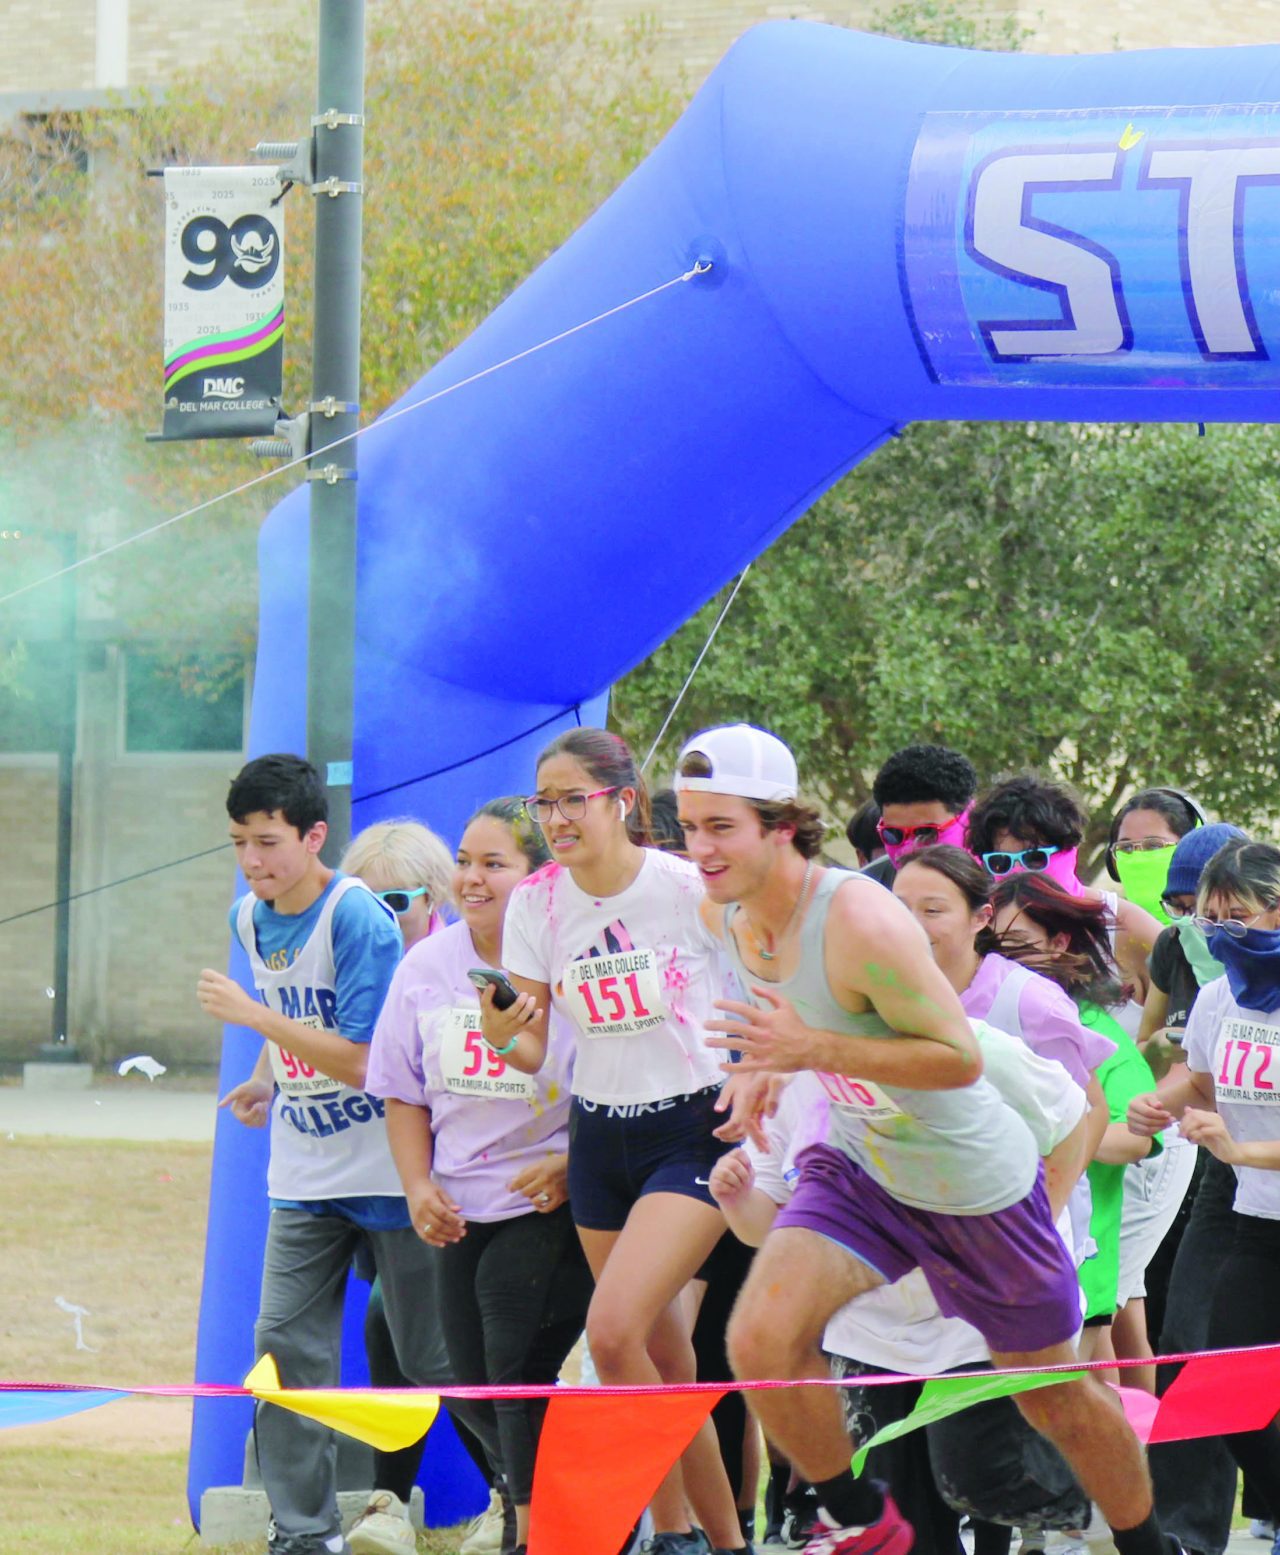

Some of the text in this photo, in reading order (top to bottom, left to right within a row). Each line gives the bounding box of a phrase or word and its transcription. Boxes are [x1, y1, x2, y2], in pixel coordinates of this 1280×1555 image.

[252, 177, 275, 186] 2025
[211, 191, 234, 200] 2025
[181, 214, 280, 292] 90
[168, 303, 189, 311] 1935
[196, 325, 220, 334] 2025
[202, 377, 245, 398] DMC
[180, 400, 265, 412] DEL MAR COLLEGE
[579, 965, 594, 980] DEL
[595, 960, 614, 977] MAR
[614, 955, 650, 974] COLLEGE
[278, 986, 339, 1028] MAR
[577, 972, 650, 1024] 151
[463, 1014, 477, 1029] DEL
[634, 1015, 666, 1031] SPORTS
[463, 1031, 506, 1077] 59
[1219, 1039, 1273, 1090] 172
[494, 1081, 526, 1094] SPORTS
[607, 1098, 677, 1118] NIKE
